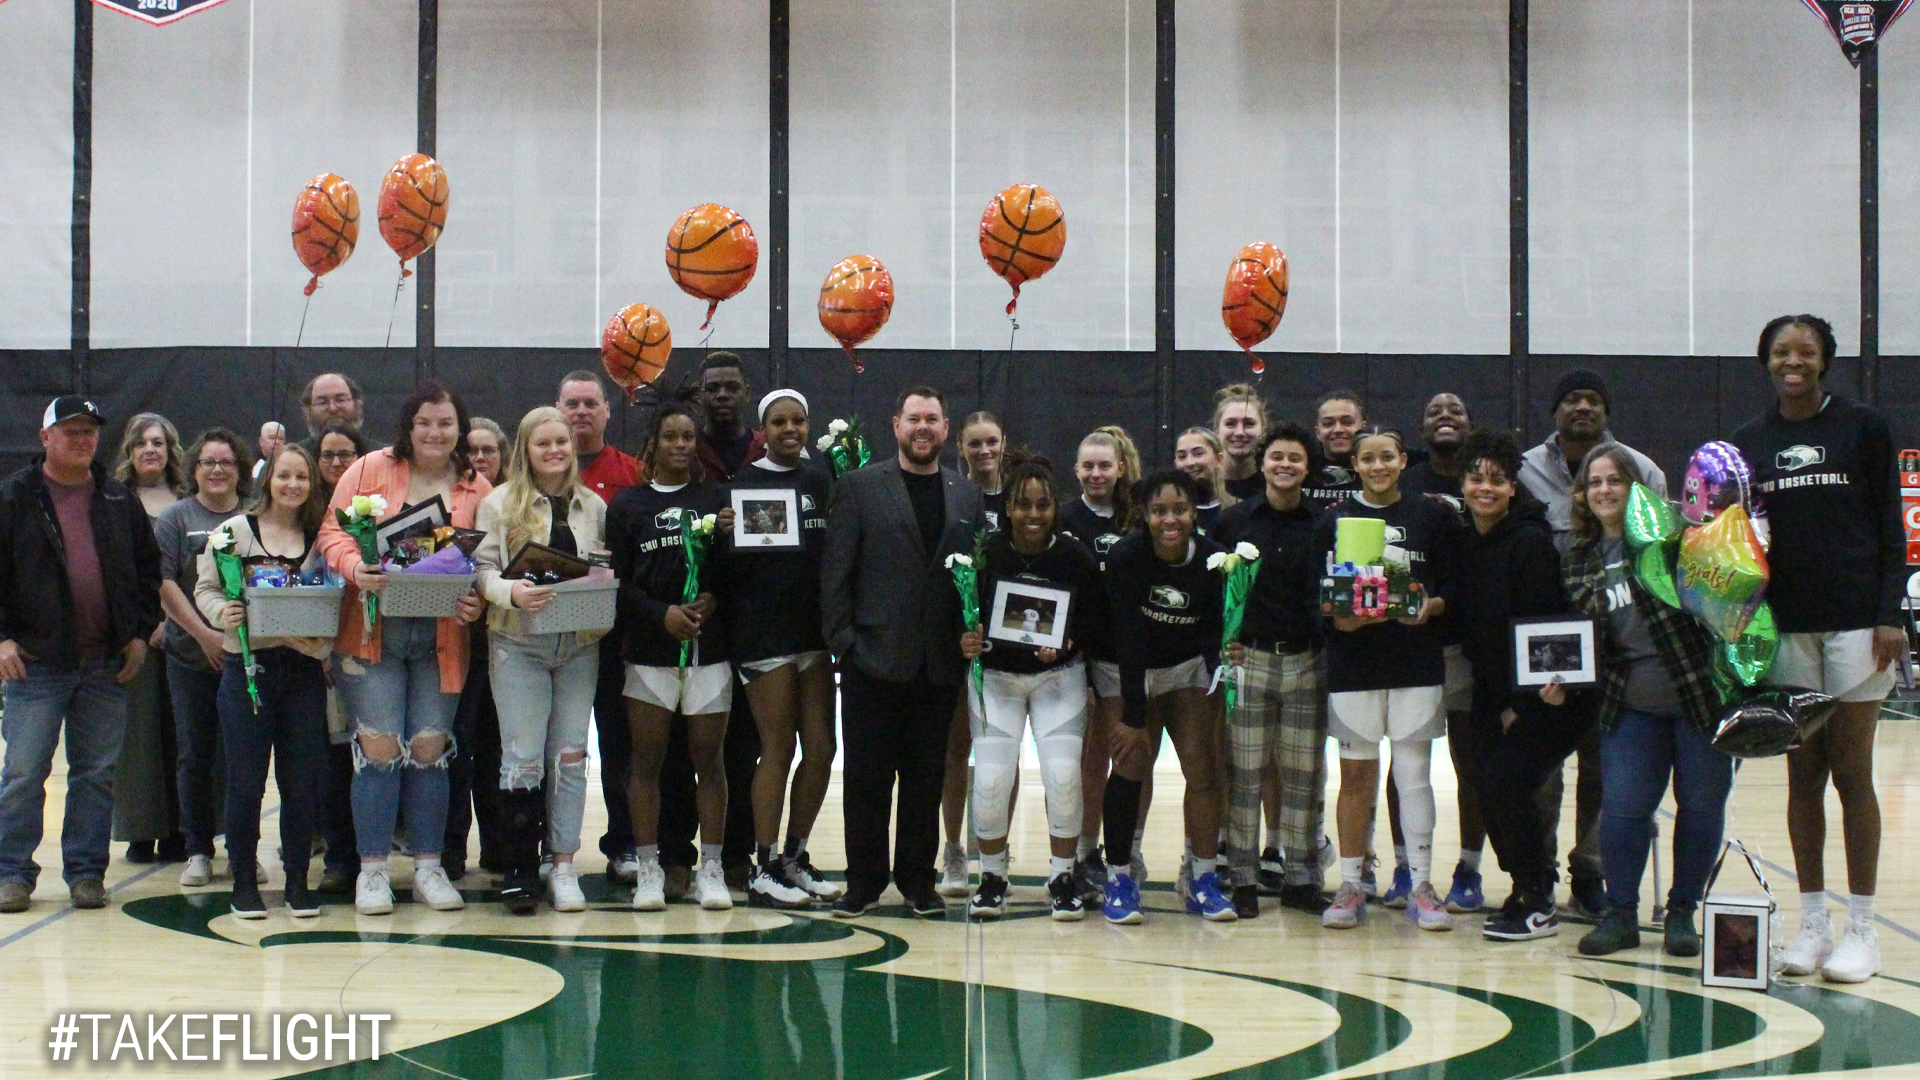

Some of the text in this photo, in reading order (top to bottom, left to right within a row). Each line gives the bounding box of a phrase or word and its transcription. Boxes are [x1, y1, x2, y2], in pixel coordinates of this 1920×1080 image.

[137, 0, 178, 10] 2020
[1779, 473, 1849, 489] BASKETBALL
[1908, 474, 1917, 484] G
[640, 539, 658, 553] CMU
